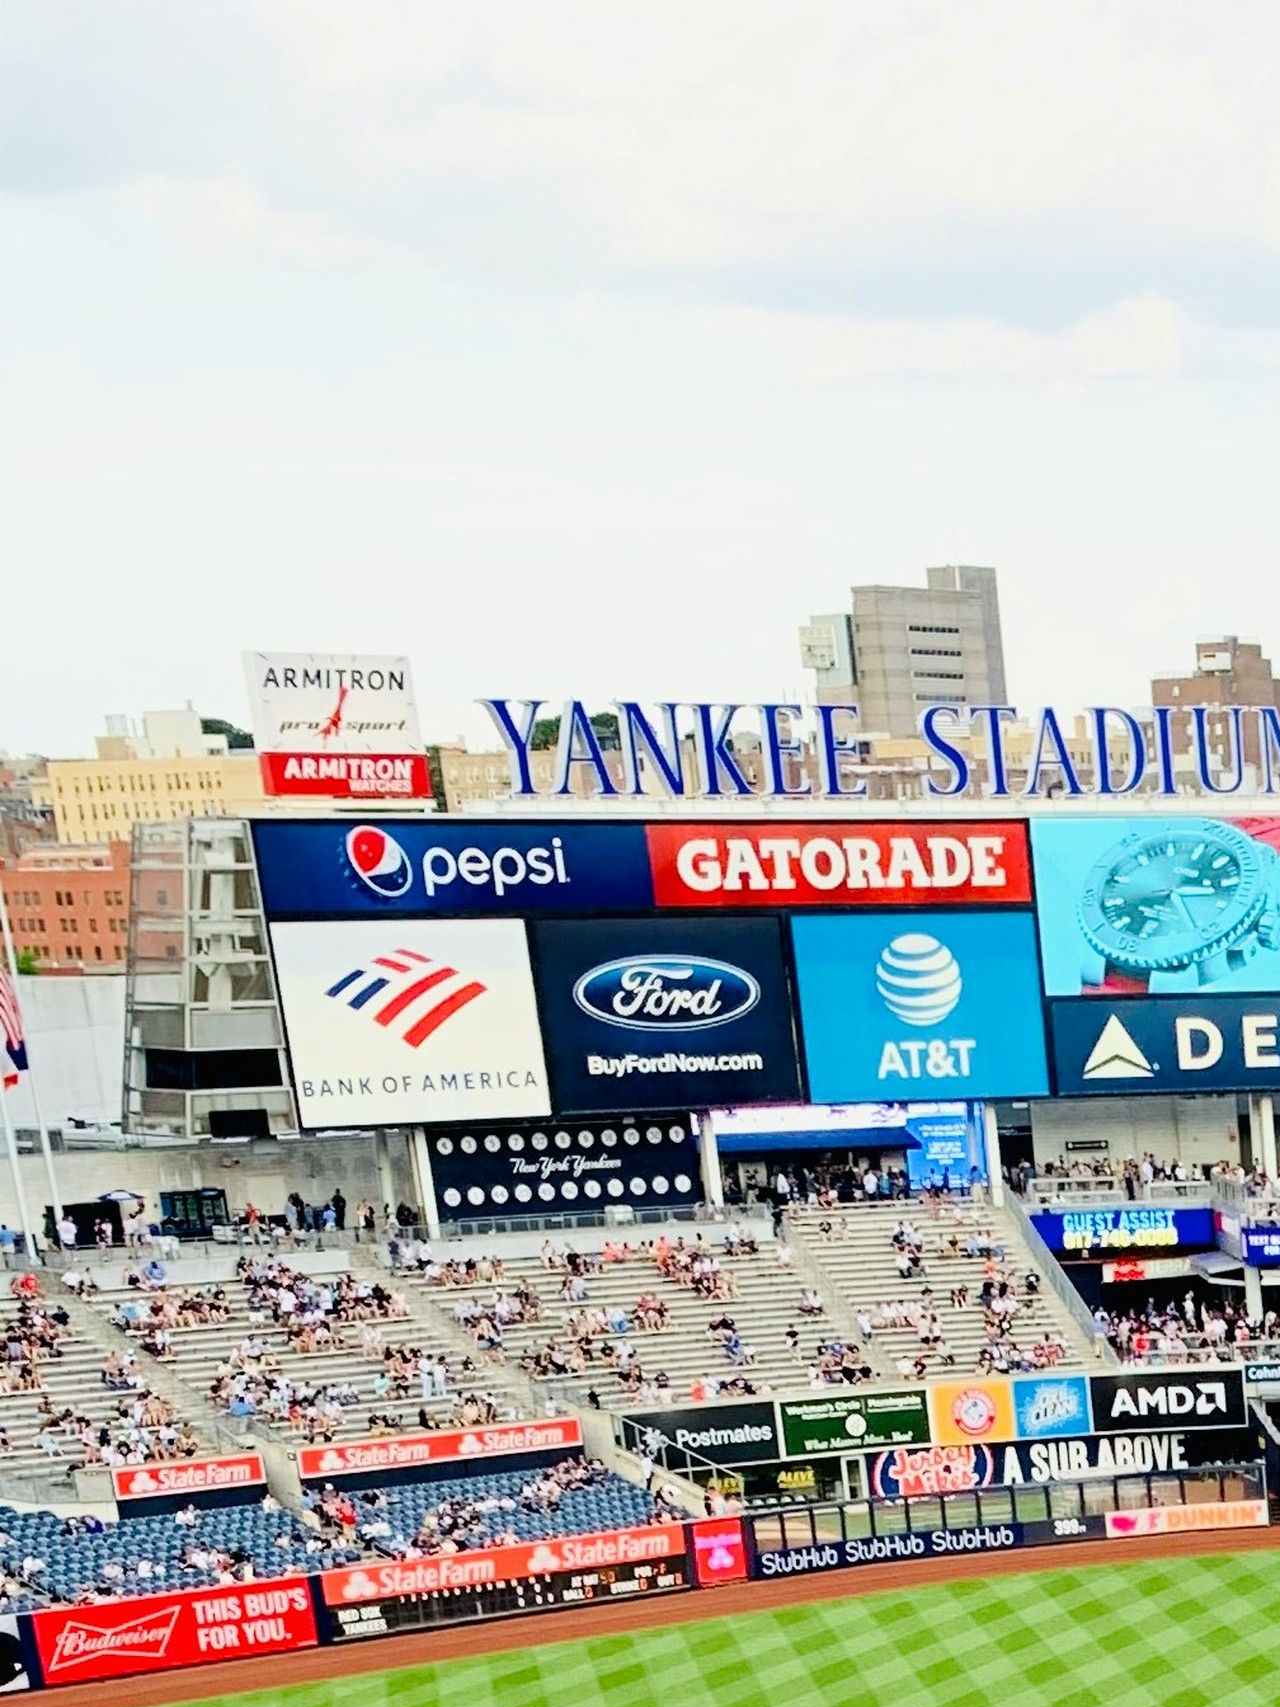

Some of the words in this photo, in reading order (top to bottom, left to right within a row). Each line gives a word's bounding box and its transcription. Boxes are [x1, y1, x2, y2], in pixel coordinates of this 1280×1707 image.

[263, 667, 406, 692] ARMITRON
[476, 699, 868, 797] YANKEE
[284, 756, 414, 783] ARMITRON
[348, 779, 413, 793] WATCHES
[423, 837, 571, 896] pepsi
[676, 836, 1007, 892] GATORADE
[612, 964, 722, 1019] Ford
[587, 1051, 764, 1078] BuyFordNow.com
[877, 1039, 977, 1080] AT&T
[302, 1076, 373, 1099] BANK
[382, 1075, 414, 1094] OF
[421, 1070, 539, 1093] AMERICA
[509, 1157, 539, 1175] New
[540, 1155, 570, 1180] York
[1062, 1212, 1115, 1231] GUEST
[1118, 1210, 1176, 1229] ASSIST
[1110, 1384, 1199, 1418] AMD
[674, 1421, 773, 1451] Postmates
[893, 1444, 974, 1475] Jersey
[1002, 1446, 1024, 1485] A
[1030, 1440, 1089, 1483] SUB
[1096, 1433, 1189, 1477] ABOVE
[777, 1467, 816, 1483] ALEVE
[1053, 1518, 1077, 1536] 399
[1164, 1504, 1263, 1529] DUNKIN'
[761, 1548, 839, 1575] StubHub
[844, 1534, 925, 1562] StubHub
[931, 1525, 1015, 1554] StubHub
[191, 1596, 242, 1626] THIS
[242, 1587, 309, 1619] BUD'S
[56, 1624, 170, 1657] Budweiser
[197, 1624, 239, 1653] FOR
[240, 1617, 293, 1645] YOU.
